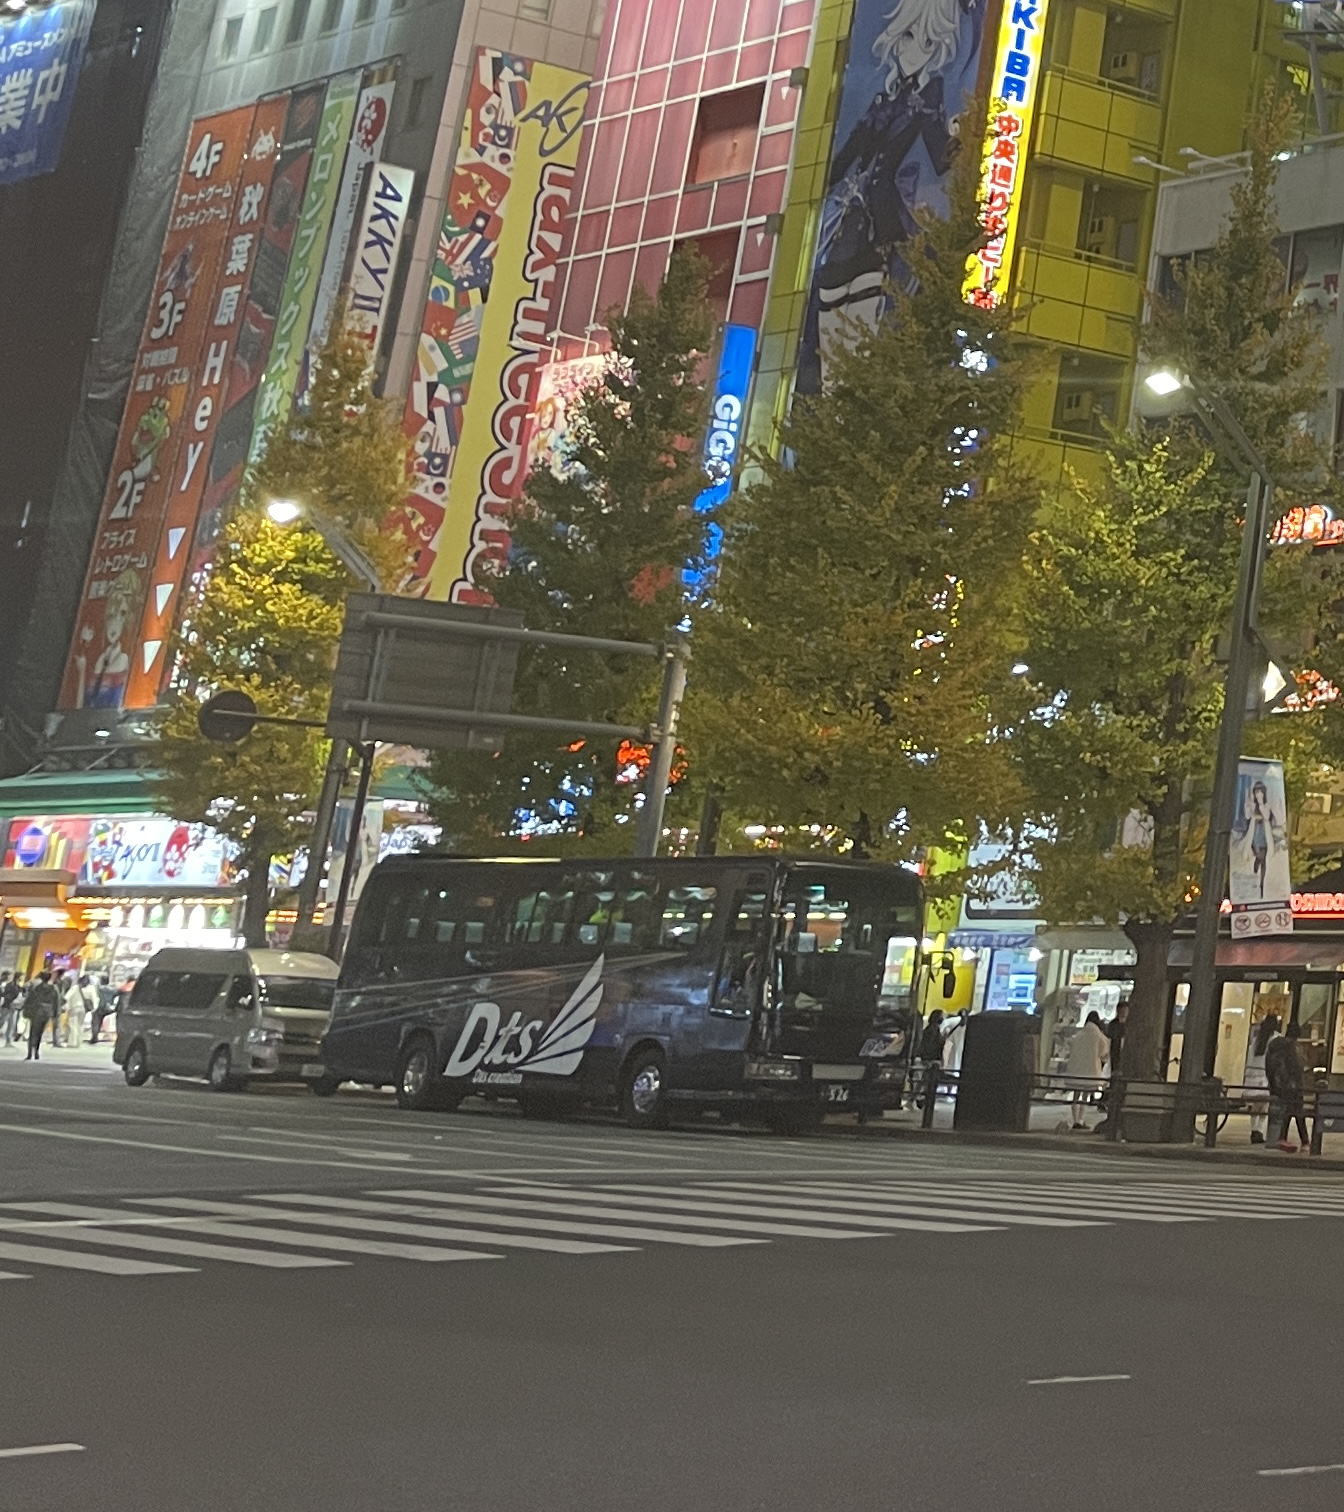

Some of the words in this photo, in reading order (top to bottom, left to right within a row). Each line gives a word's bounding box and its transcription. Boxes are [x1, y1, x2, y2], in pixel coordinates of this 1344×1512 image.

[188, 133, 224, 178] 4F
[214, 182, 263, 327] 秋葉原
[361, 171, 403, 291] AKKY
[150, 291, 185, 340] 3F
[181, 341, 228, 491] Hey
[109, 470, 146, 521] 2F
